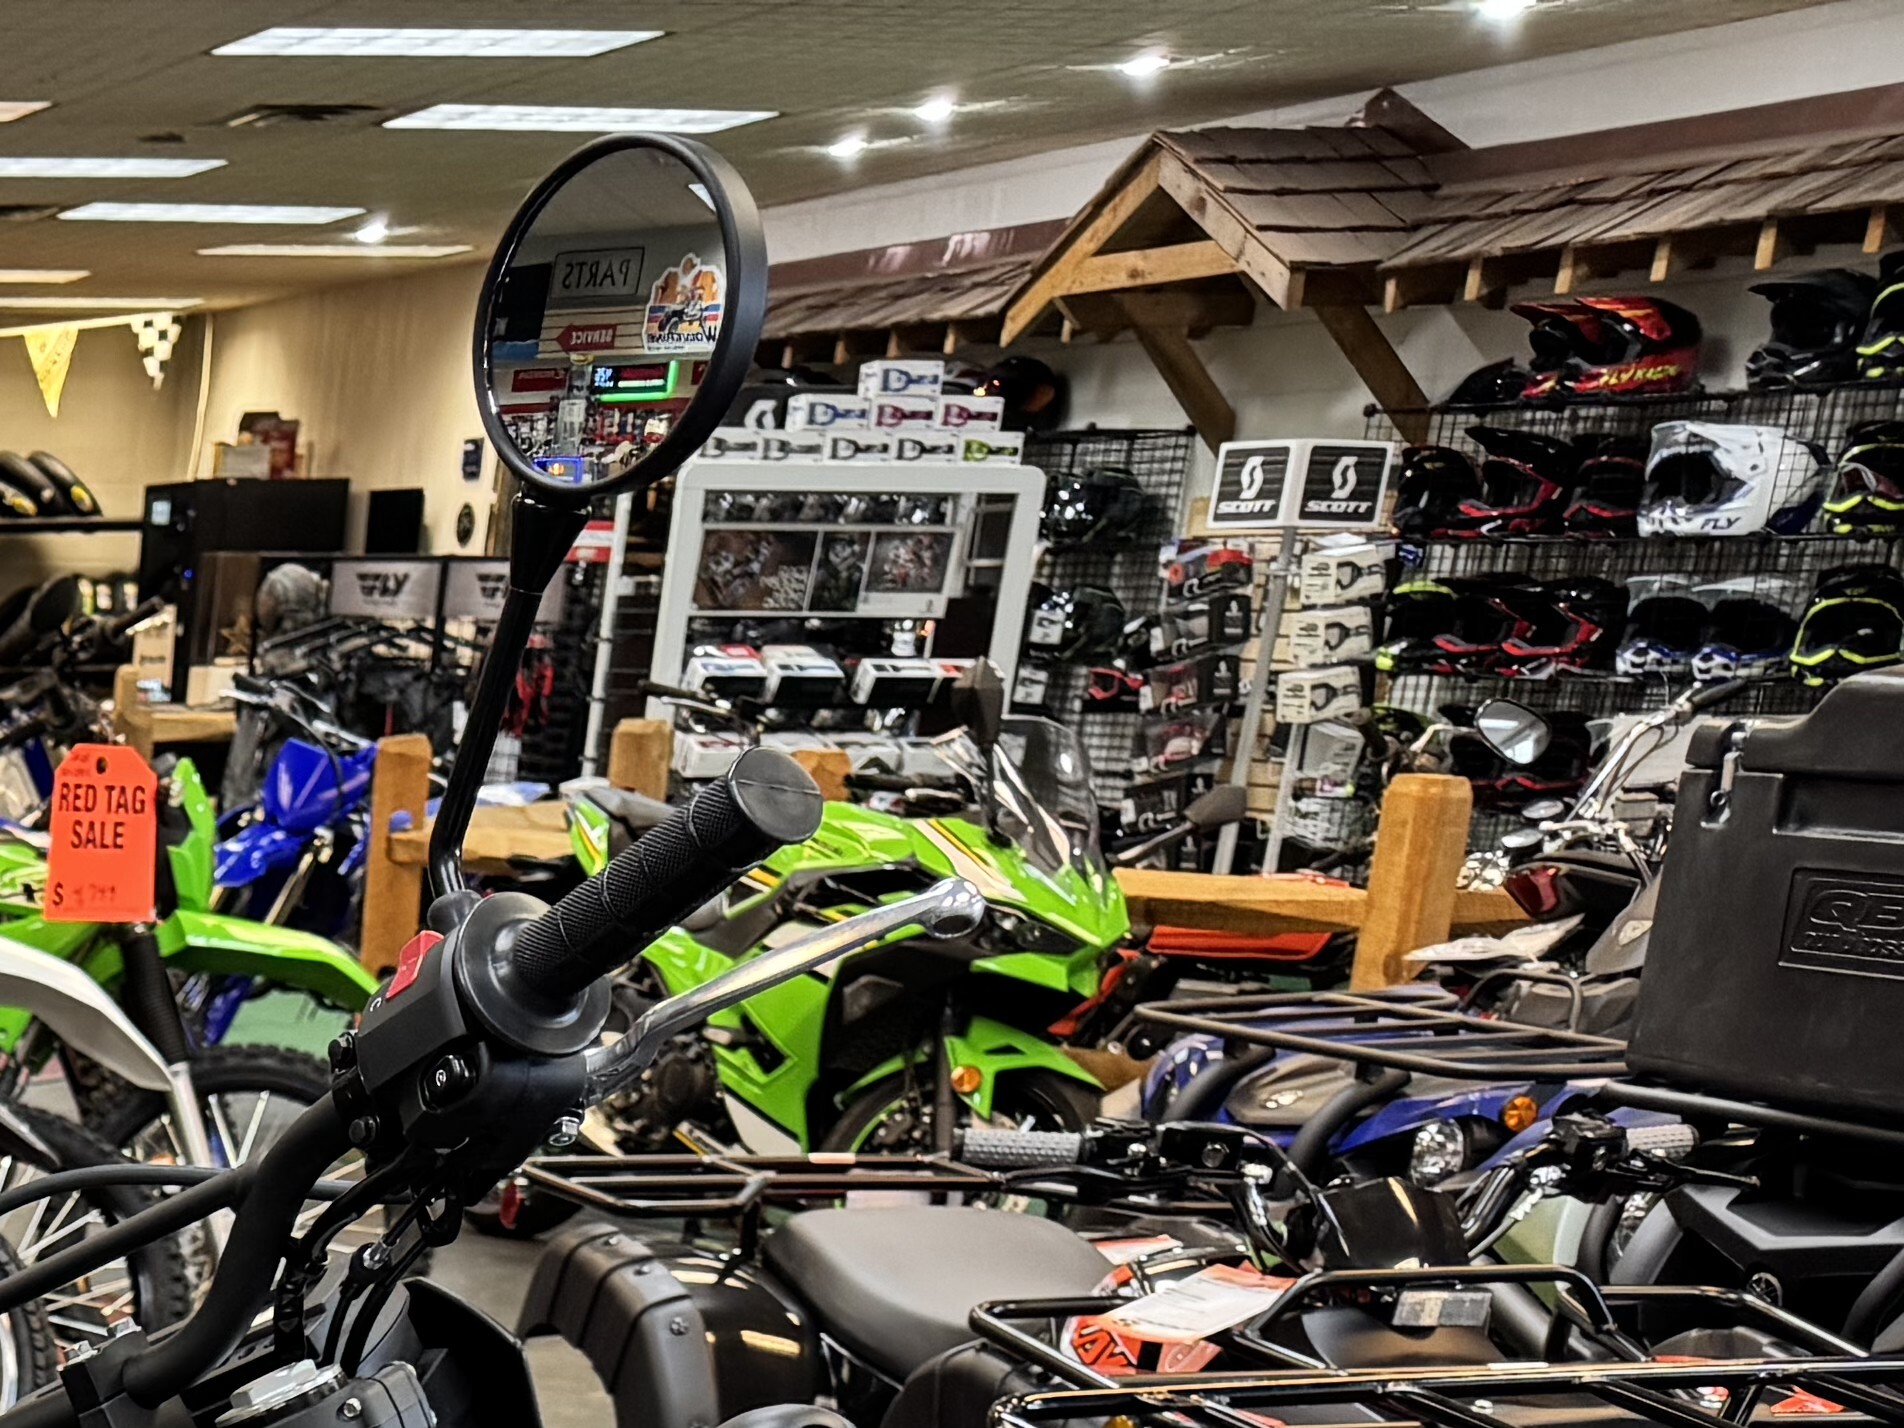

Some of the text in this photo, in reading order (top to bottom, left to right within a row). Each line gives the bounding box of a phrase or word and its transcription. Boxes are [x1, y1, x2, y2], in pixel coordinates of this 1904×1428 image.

[1216, 500, 1276, 514] SCOTT
[1304, 500, 1372, 513] SCOTT
[1700, 516, 1741, 531] FLY
[59, 782, 145, 815] RED TAG
[71, 820, 125, 849] SALE
